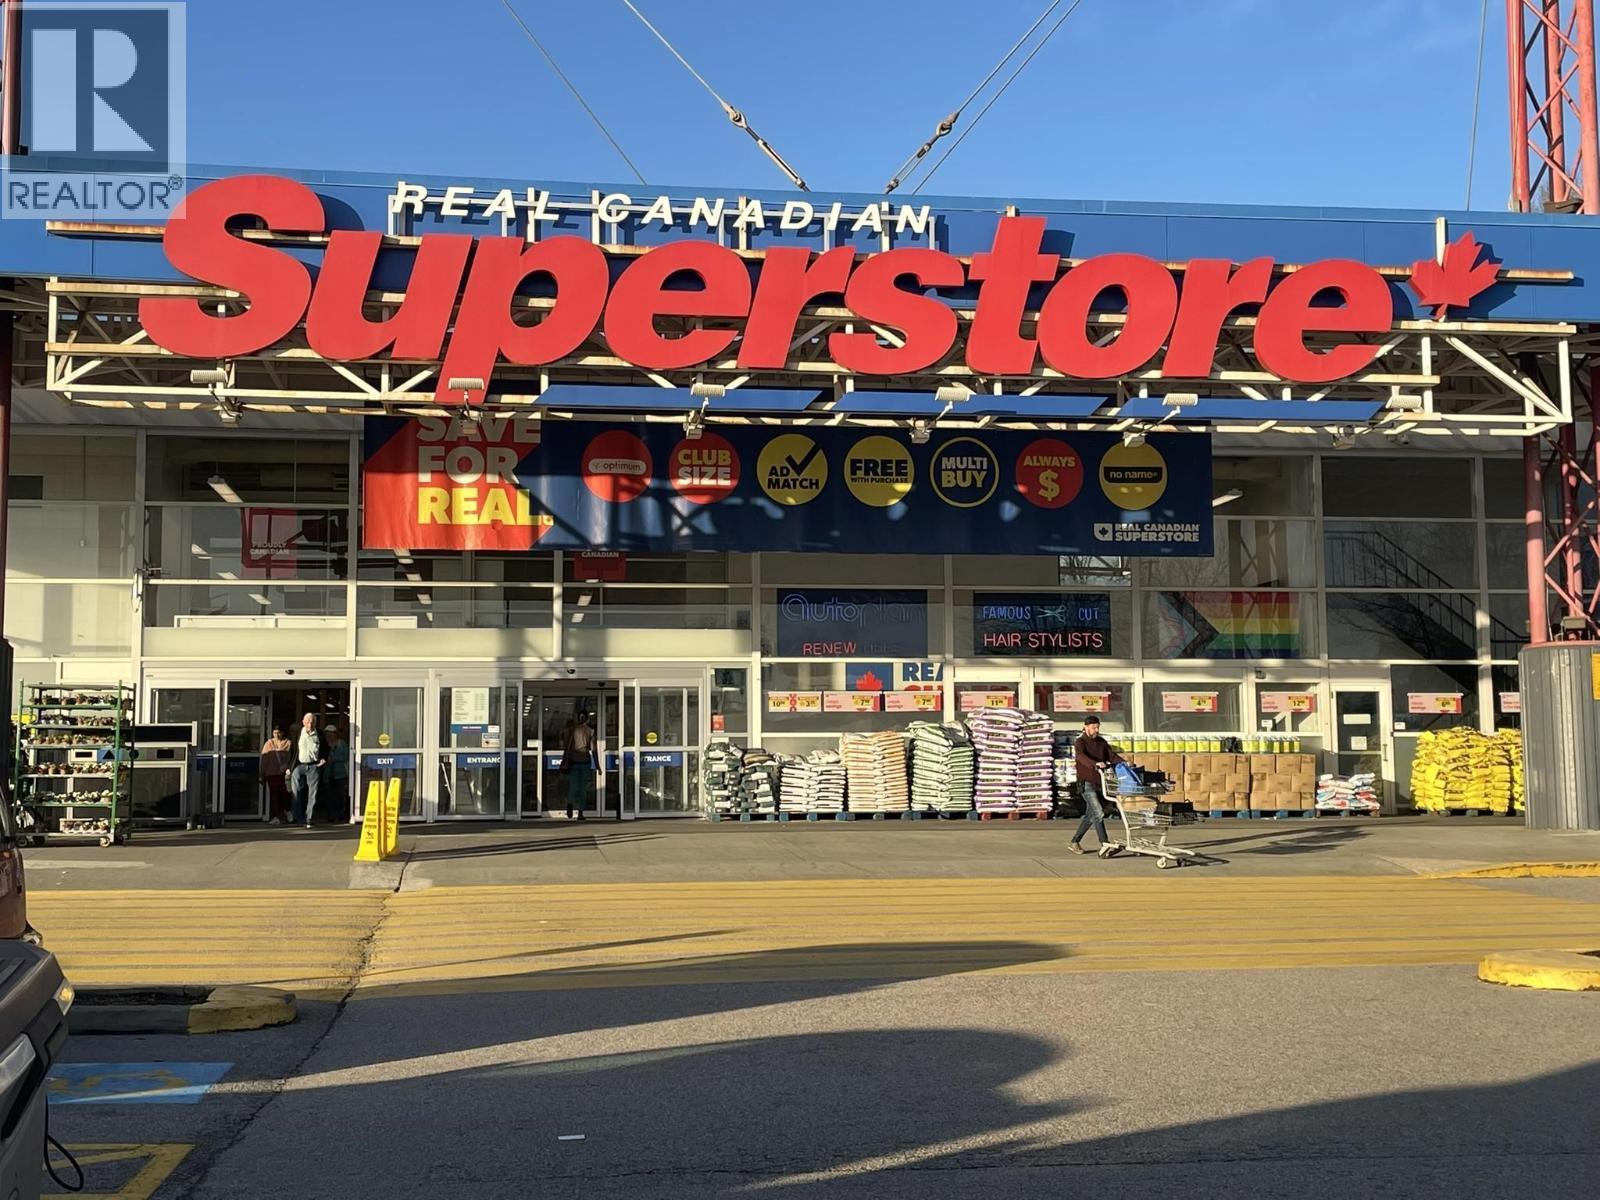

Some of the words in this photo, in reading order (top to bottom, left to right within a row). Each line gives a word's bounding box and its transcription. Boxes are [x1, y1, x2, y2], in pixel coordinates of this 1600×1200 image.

[392, 182, 563, 221] REAL
[598, 193, 931, 234] CANADIAN
[140, 174, 1395, 405] Superstore
[416, 416, 541, 443] SAVE
[678, 449, 731, 465] CLUB
[942, 457, 988, 469] MULTI
[1024, 456, 1076, 467] ALWAYS
[418, 446, 519, 484] FOR
[603, 462, 641, 472] optimum
[768, 466, 790, 477] AD
[851, 459, 908, 476] FREE
[678, 467, 731, 486] SIZE
[942, 471, 987, 488] BUY
[1110, 471, 1122, 479] no
[767, 478, 819, 489] MATCH
[1038, 469, 1060, 502] $
[1143, 524, 1199, 532] CANADIAN
[1115, 532, 1199, 542] SUPERSTORE
[983, 606, 1031, 620] FAMOUS
[1078, 608, 1100, 620] CUT
[984, 633, 1021, 647] HAIR
[1028, 632, 1103, 648] STYLISTS
[803, 642, 857, 655] RENEW
